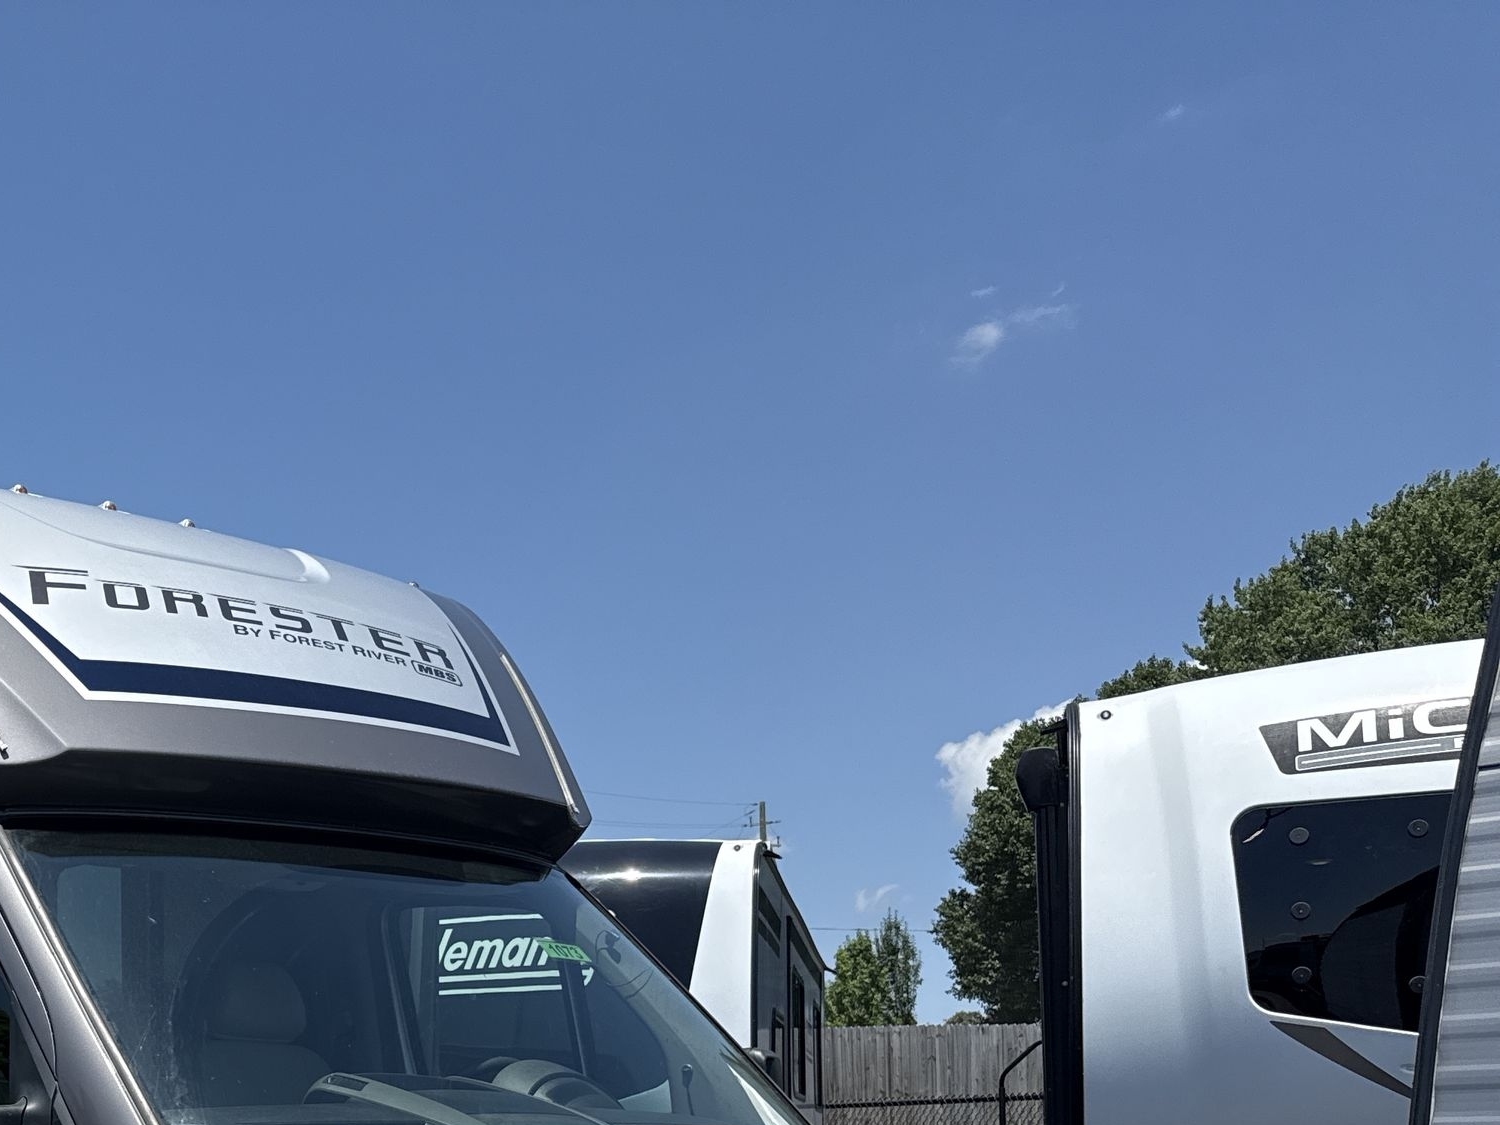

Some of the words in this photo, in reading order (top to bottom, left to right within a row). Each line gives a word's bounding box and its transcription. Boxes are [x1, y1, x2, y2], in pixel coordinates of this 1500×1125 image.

[12, 565, 455, 670] FORESTER
[233, 623, 262, 638] BY
[269, 630, 346, 652] FOREST
[351, 645, 407, 667] RIVER
[417, 662, 458, 684] MBS
